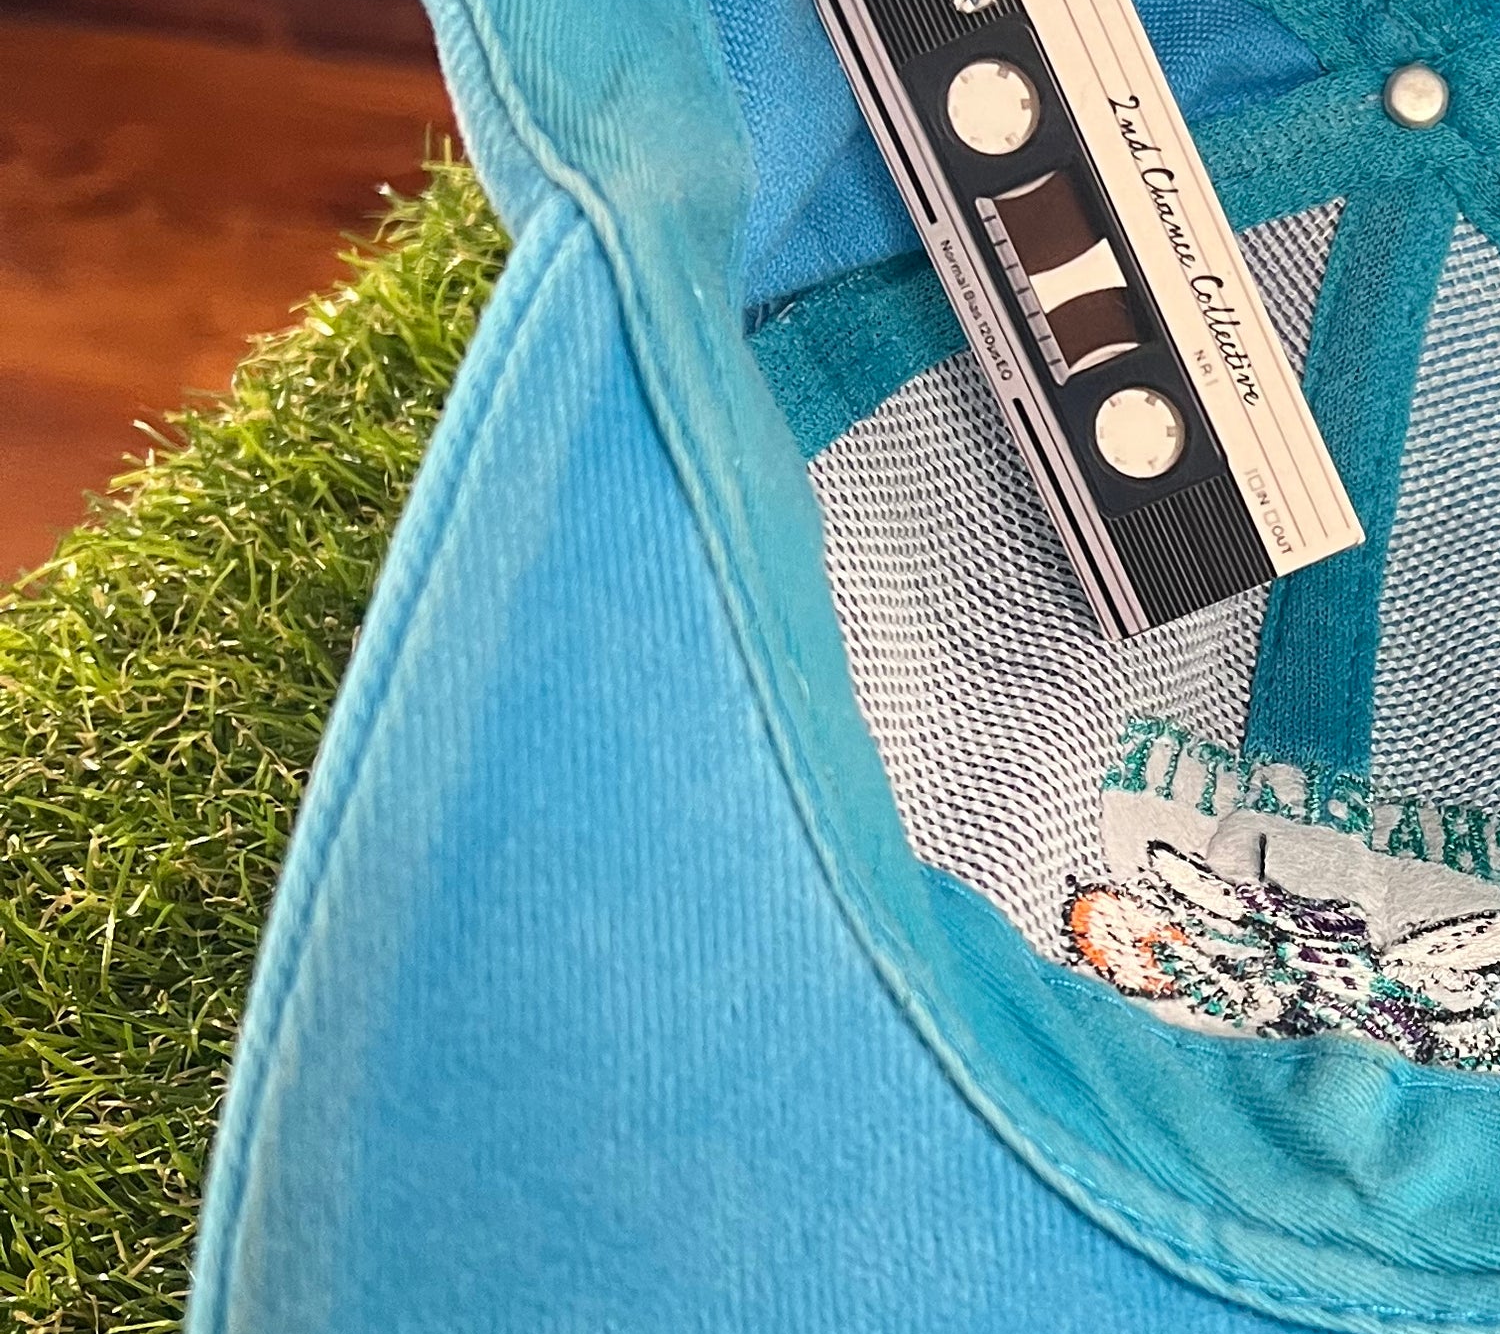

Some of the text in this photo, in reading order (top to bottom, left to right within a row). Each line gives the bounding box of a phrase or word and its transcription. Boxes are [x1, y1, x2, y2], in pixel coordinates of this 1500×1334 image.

[940, 239, 971, 290] Normal
[963, 290, 982, 321] Bias
[1106, 95, 1259, 407] 2nd Chance Collective
[1271, 525, 1294, 555] OUT
